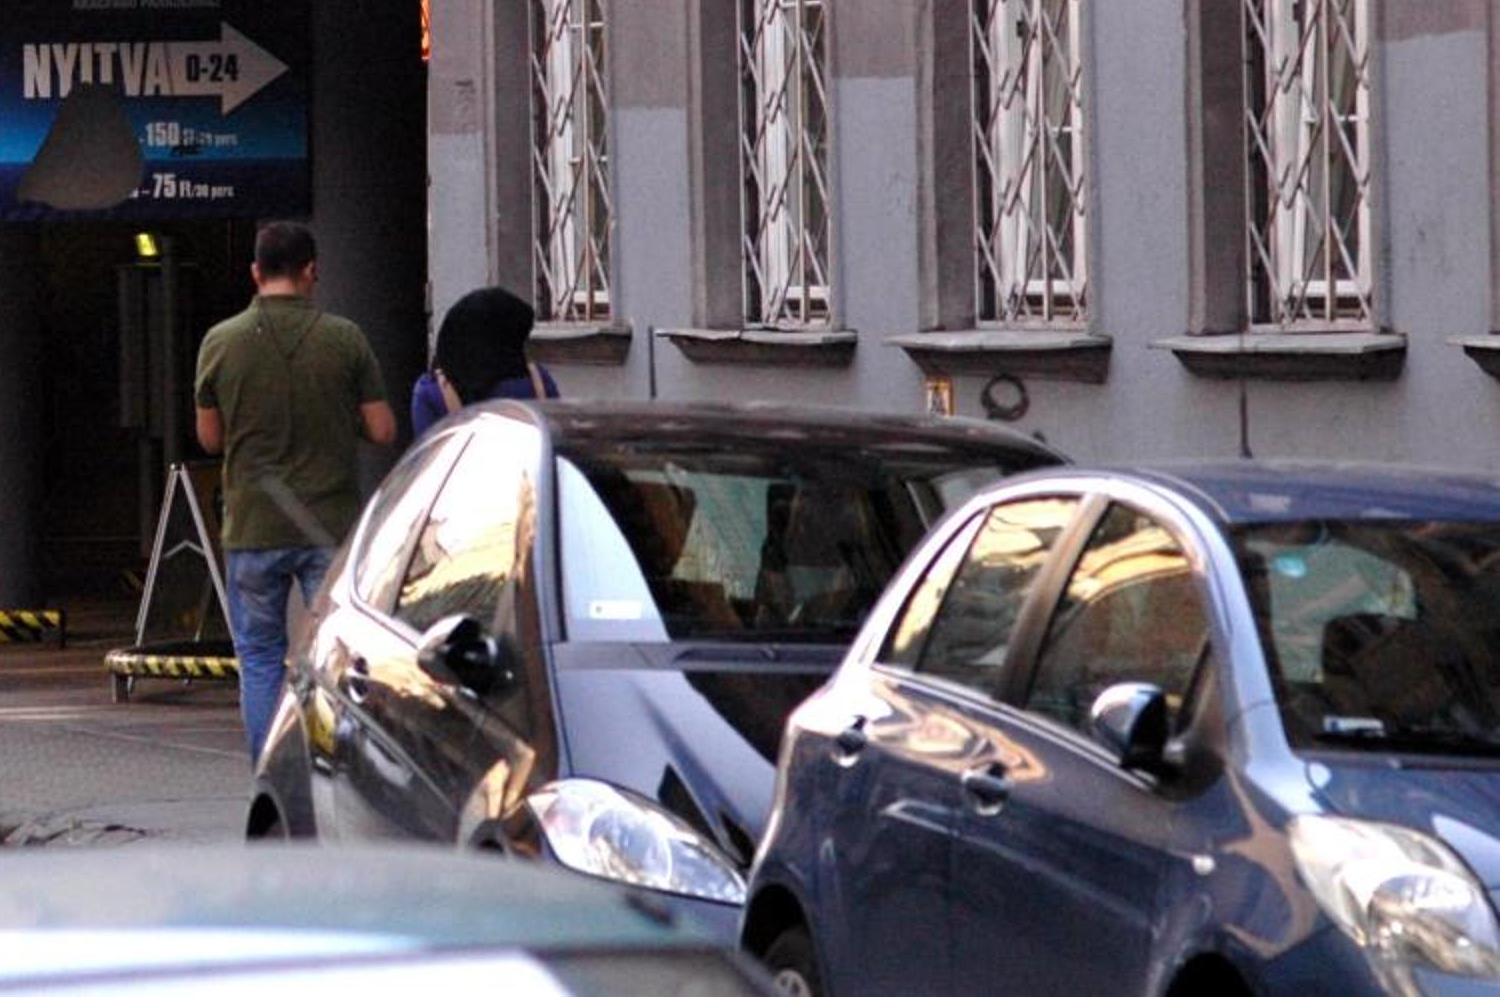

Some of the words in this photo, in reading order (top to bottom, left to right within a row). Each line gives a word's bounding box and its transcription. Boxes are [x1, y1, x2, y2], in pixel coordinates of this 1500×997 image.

[22, 42, 175, 100] NYITVA
[186, 54, 239, 83] 0-24
[145, 122, 181, 147] 150
[152, 172, 177, 199] 75
